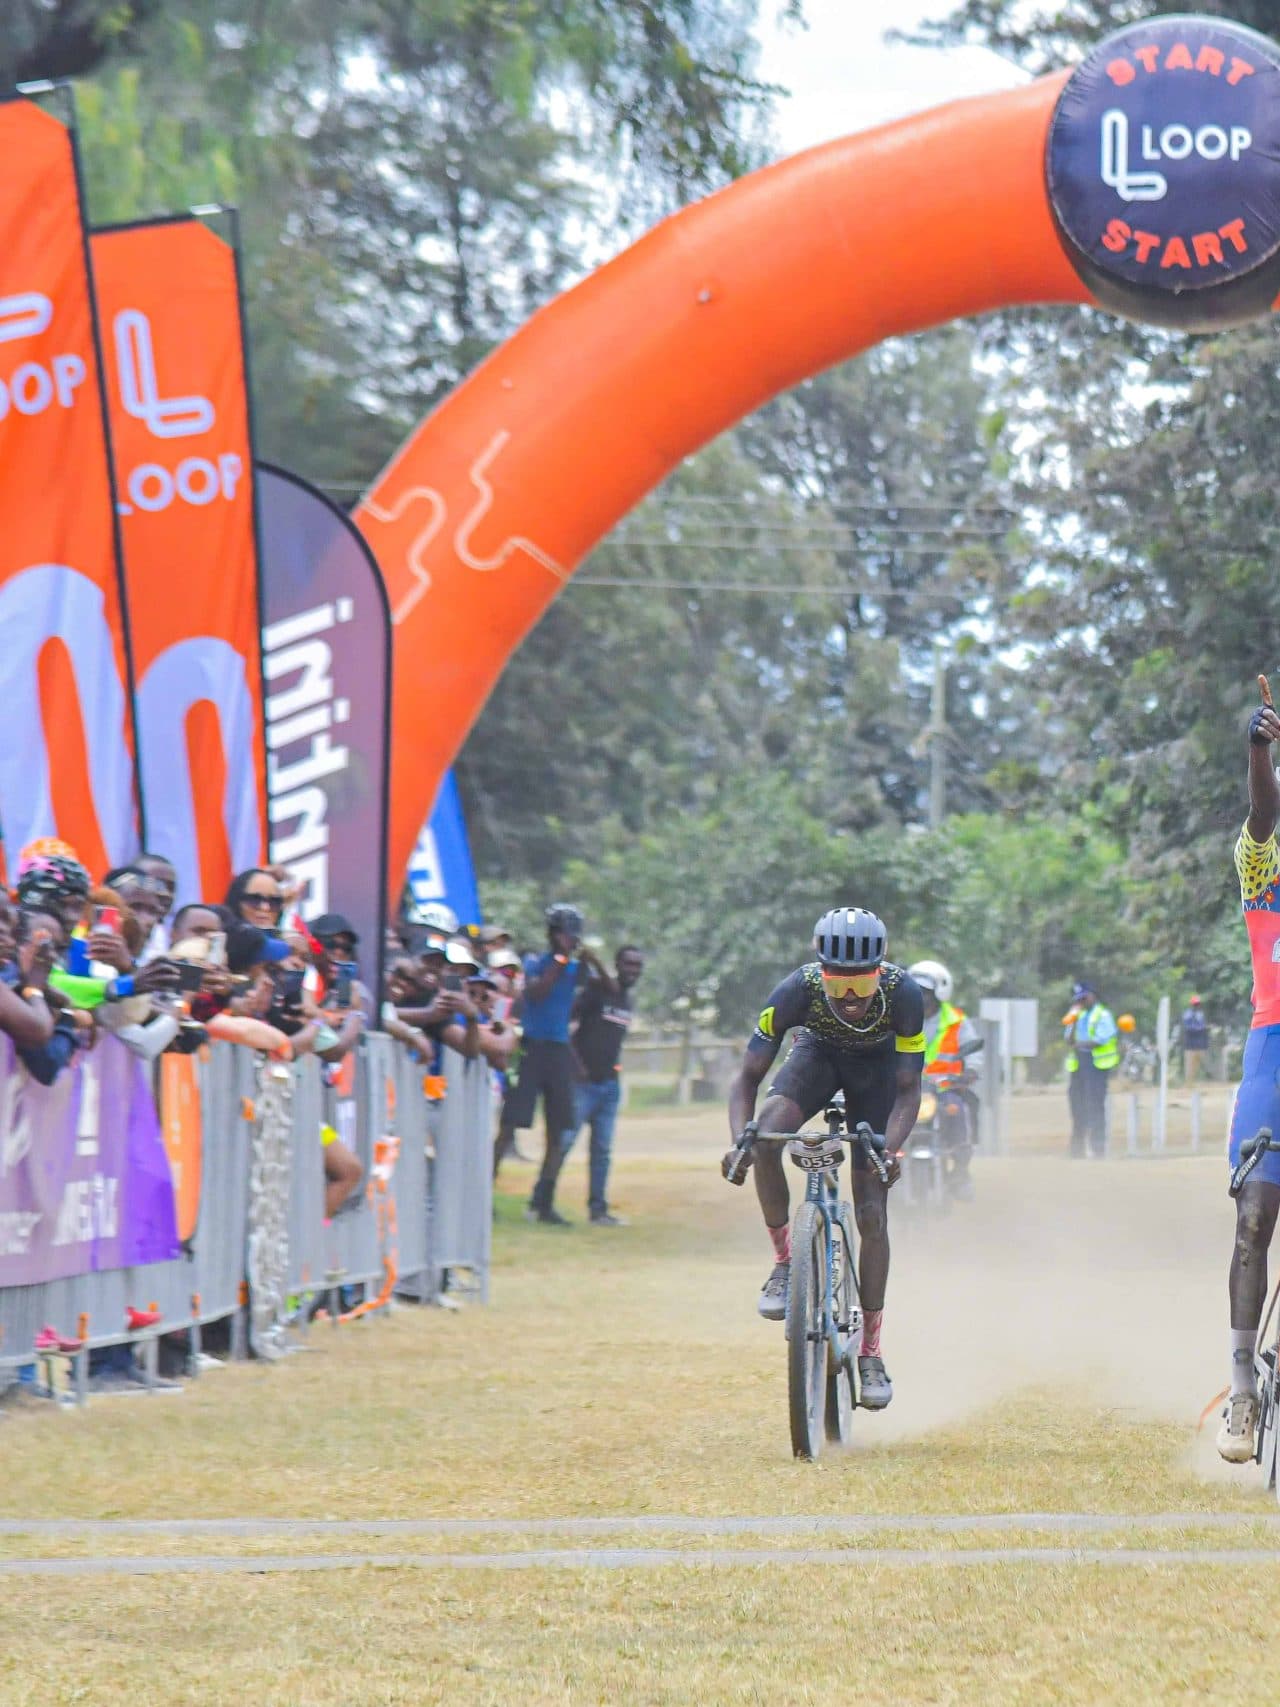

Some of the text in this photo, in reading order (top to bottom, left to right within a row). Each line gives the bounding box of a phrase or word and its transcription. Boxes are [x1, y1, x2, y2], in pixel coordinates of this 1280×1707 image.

[1105, 43, 1255, 86] START
[1142, 125, 1251, 160] LOOP
[1101, 218, 1248, 268] START
[0, 353, 87, 422] OP
[115, 452, 242, 515] OOP
[800, 1154, 835, 1168] 055
